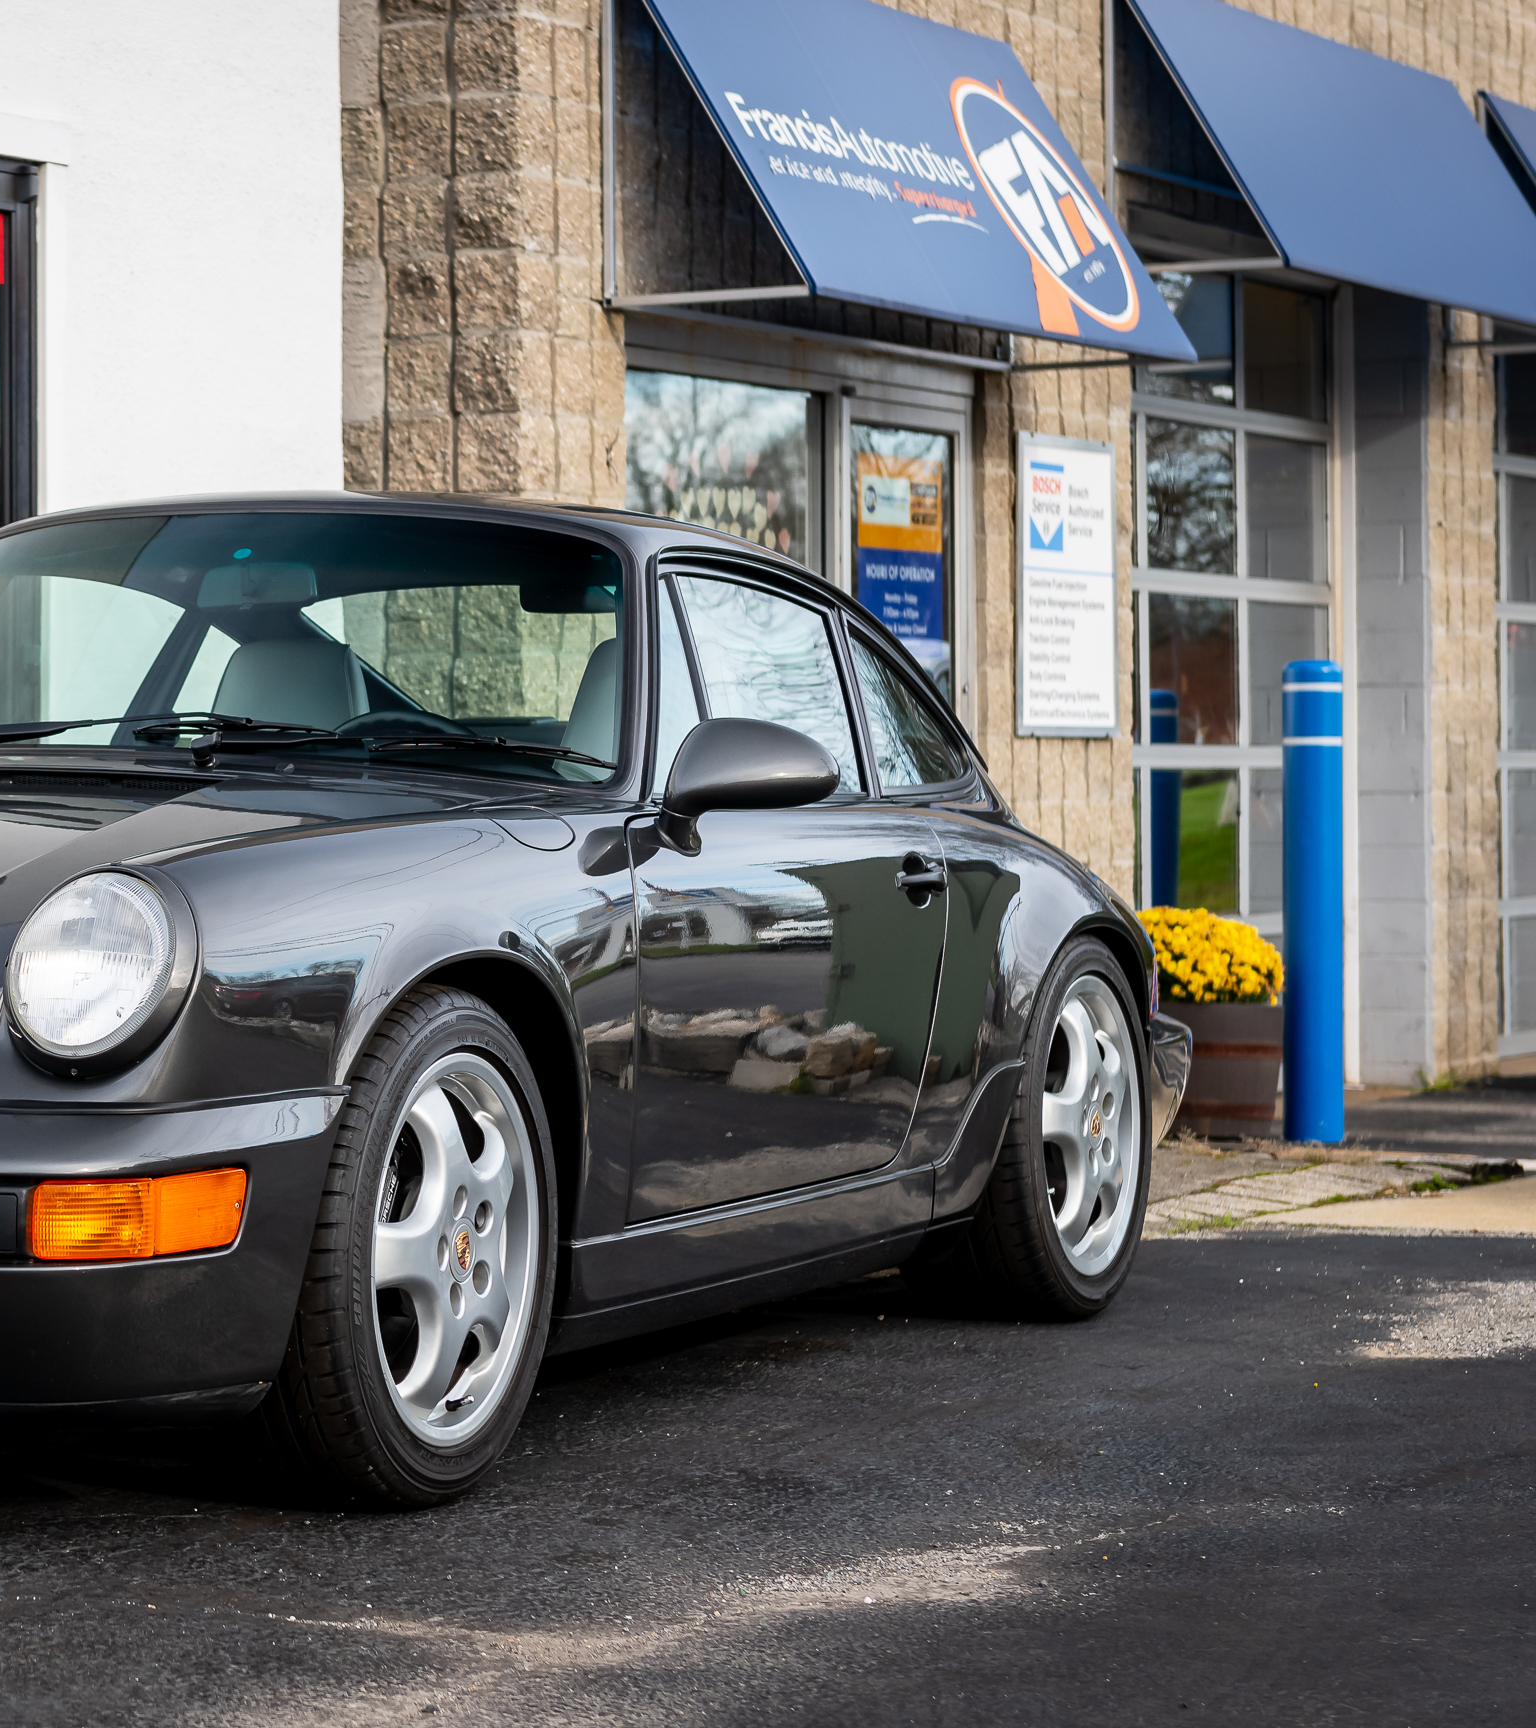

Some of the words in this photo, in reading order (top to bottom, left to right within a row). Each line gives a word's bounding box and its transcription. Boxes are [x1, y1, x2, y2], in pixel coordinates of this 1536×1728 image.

[1032, 475, 1061, 495] BOSCH
[1068, 484, 1089, 499] Bosch
[1032, 497, 1061, 516] Service
[1068, 504, 1104, 520] Authorized
[1068, 522, 1093, 538] Service
[381, 1174, 398, 1224] ORSCHE
